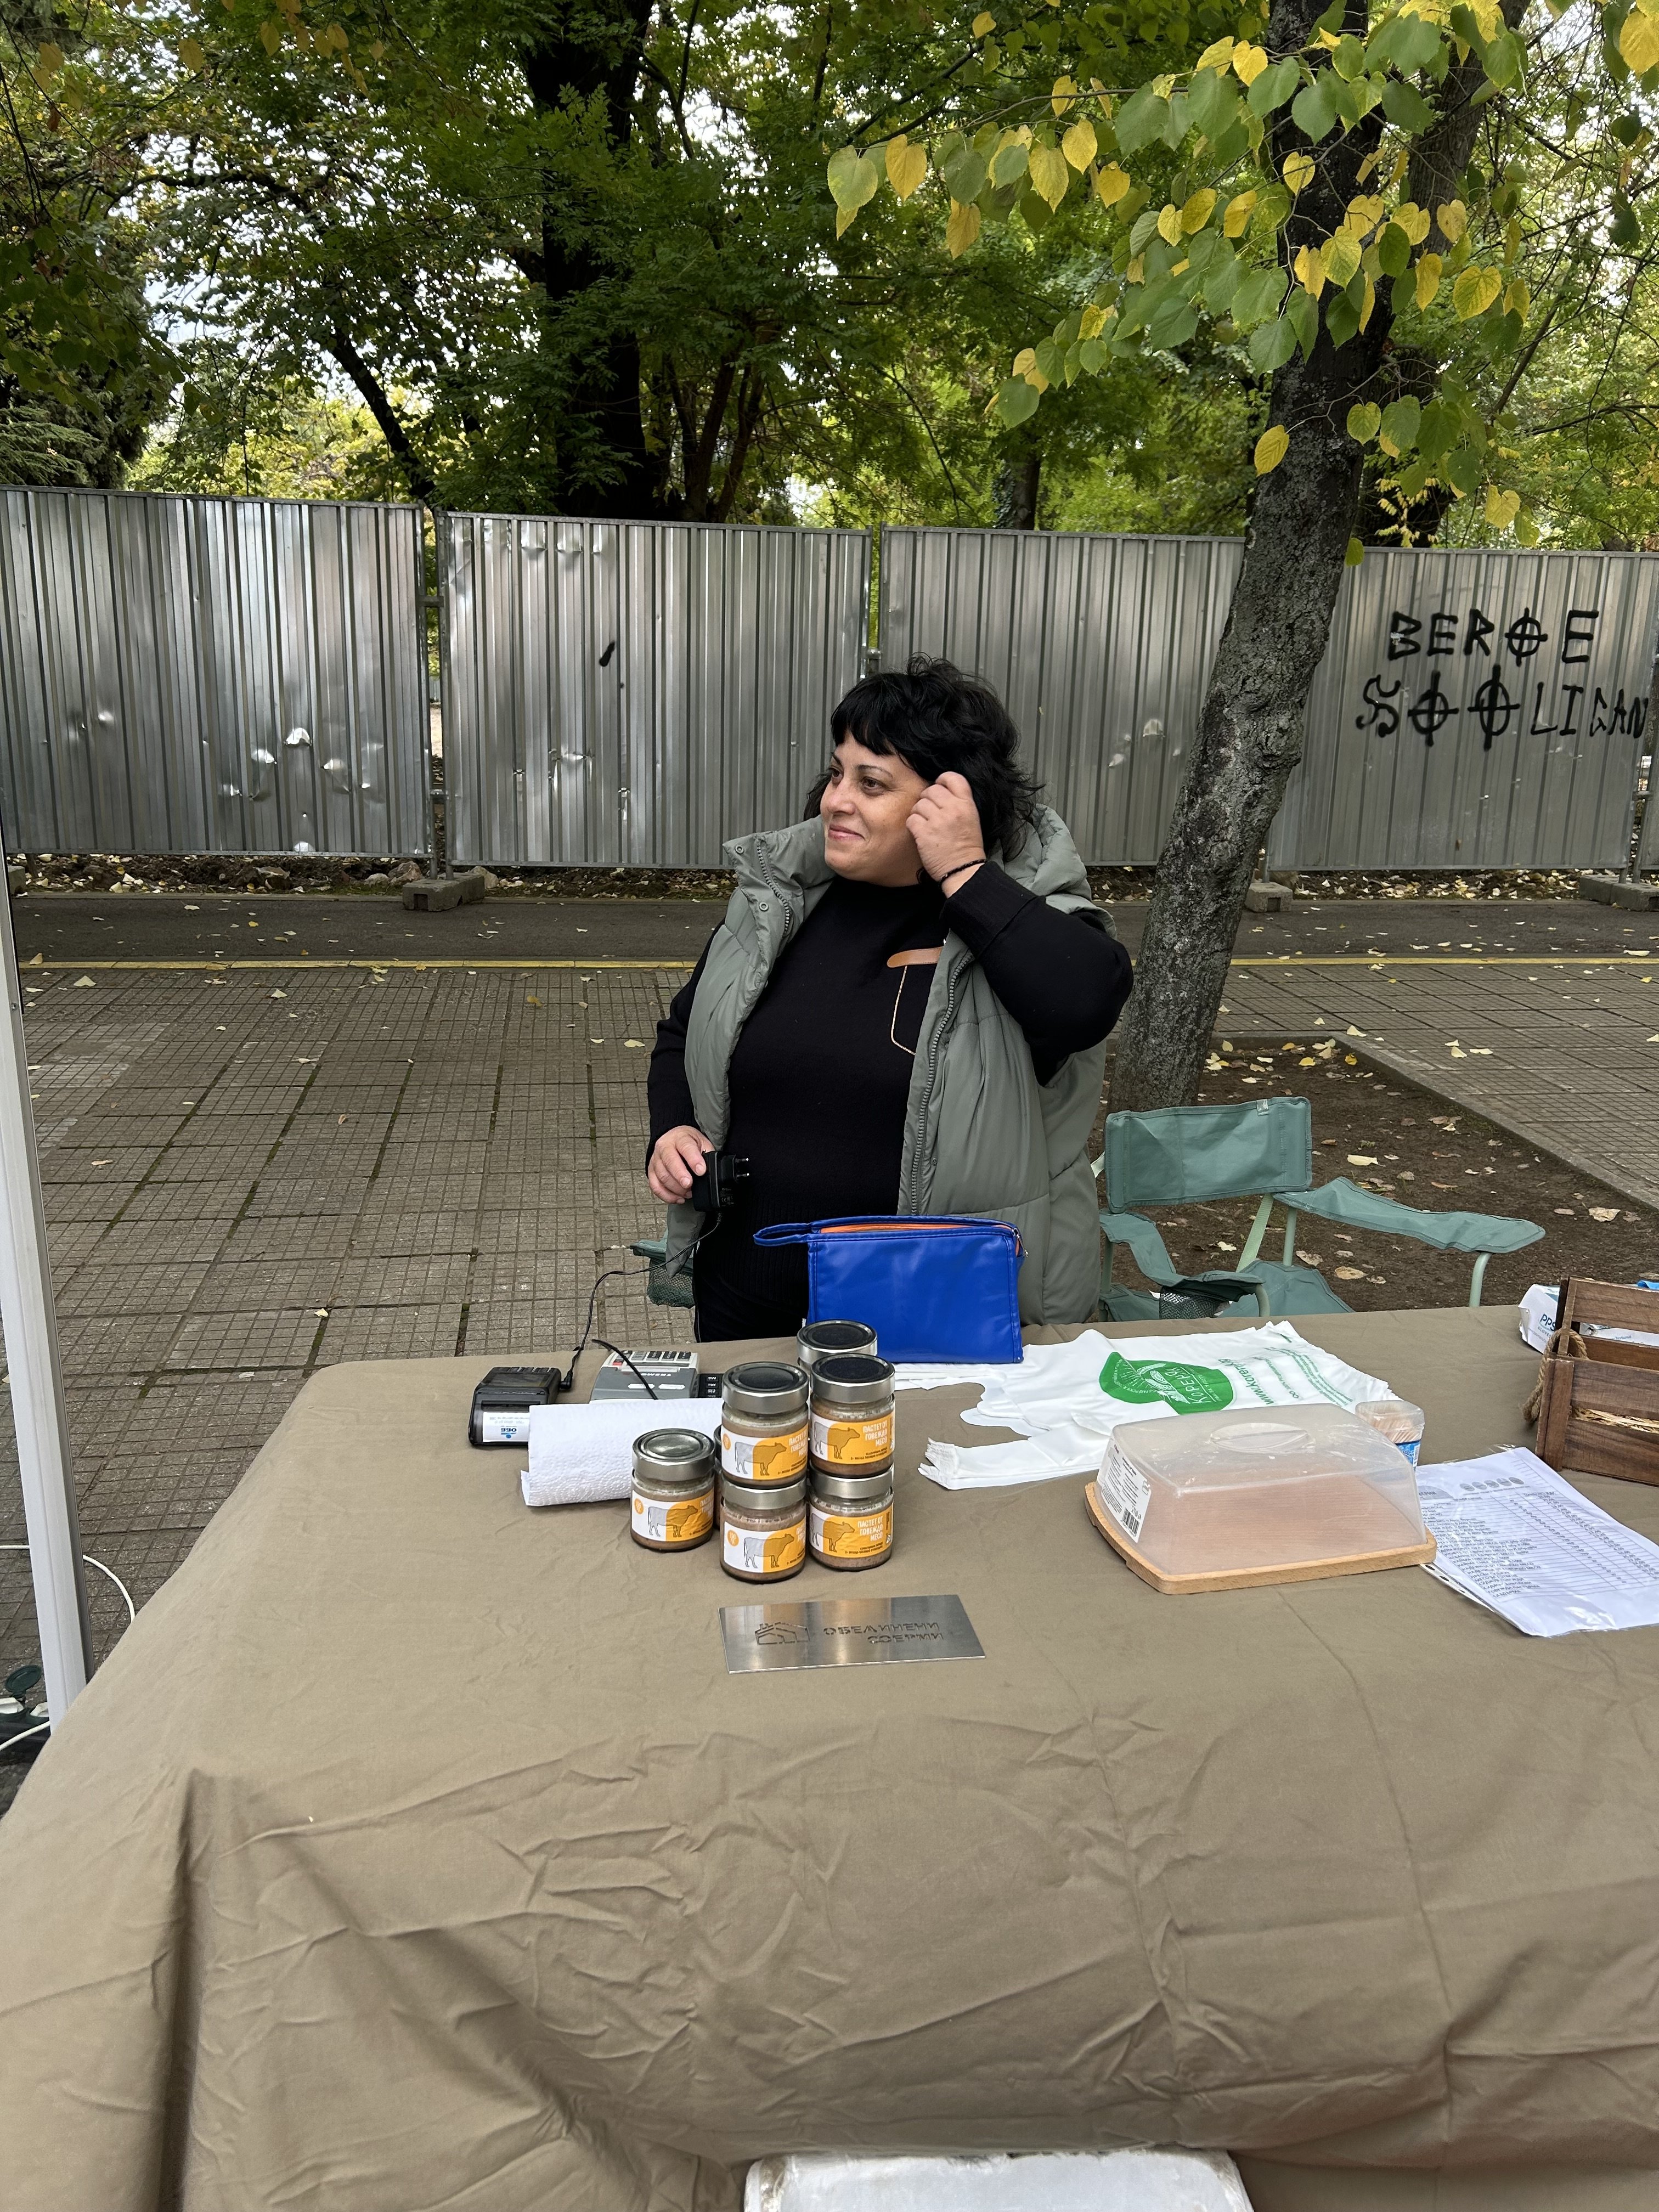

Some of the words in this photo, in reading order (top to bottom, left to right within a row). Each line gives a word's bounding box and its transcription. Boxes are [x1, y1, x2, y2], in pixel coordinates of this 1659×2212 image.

[1387, 607, 1599, 667] BEROE
[863, 1423, 882, 1433] ПАСТЕТ
[865, 1429, 888, 1441] ГОВЕЖДО
[875, 1437, 887, 1447] МЕСО
[857, 1519, 877, 1527] ПАСТЕТ
[878, 1516, 883, 1524] ОТ
[860, 1524, 883, 1536] ГОВЕЖДО
[870, 1532, 883, 1542] МЕСО
